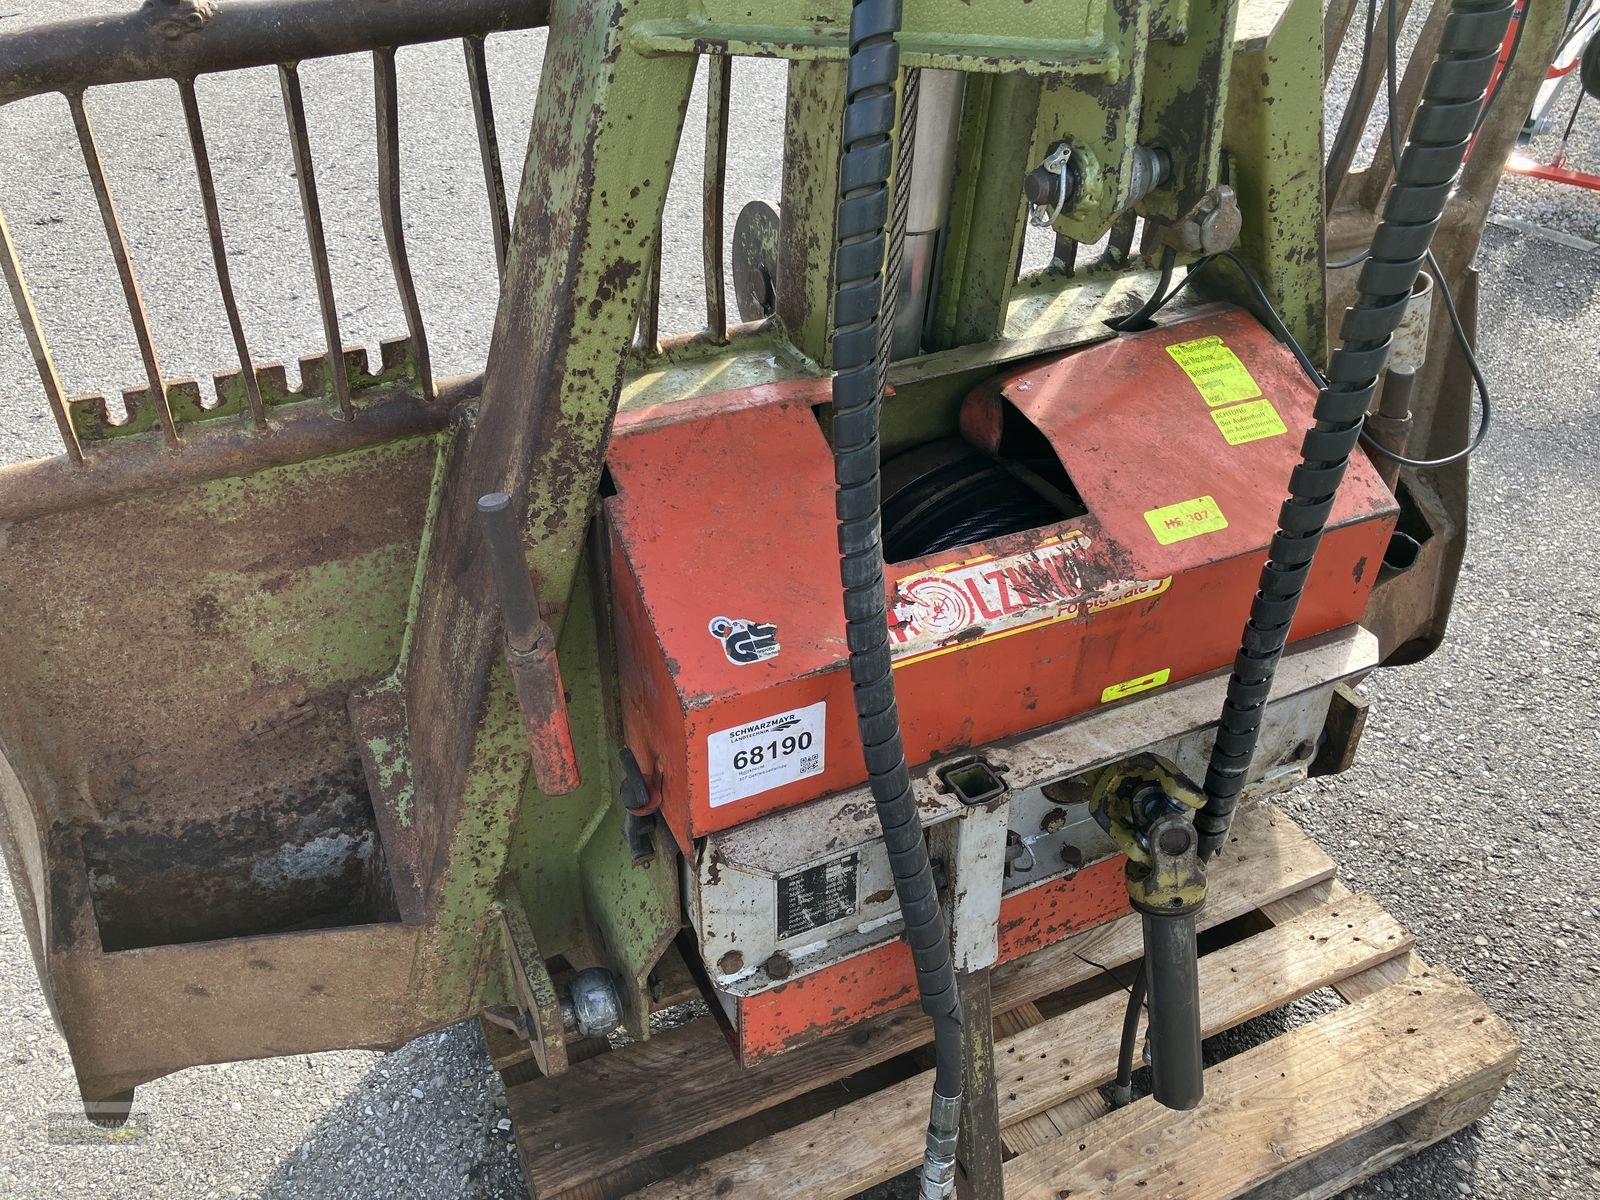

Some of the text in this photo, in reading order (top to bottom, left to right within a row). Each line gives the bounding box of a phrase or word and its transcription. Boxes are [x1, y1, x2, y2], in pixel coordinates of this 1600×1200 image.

[1215, 407, 1247, 419] ACHTUNG
[1219, 411, 1266, 426] Der Aufenthalt
[1186, 510, 1209, 523] 307
[729, 714, 795, 739] SCHWARZMAYR
[730, 728, 770, 744] LANDTECHNIK
[733, 730, 812, 770] 68190
